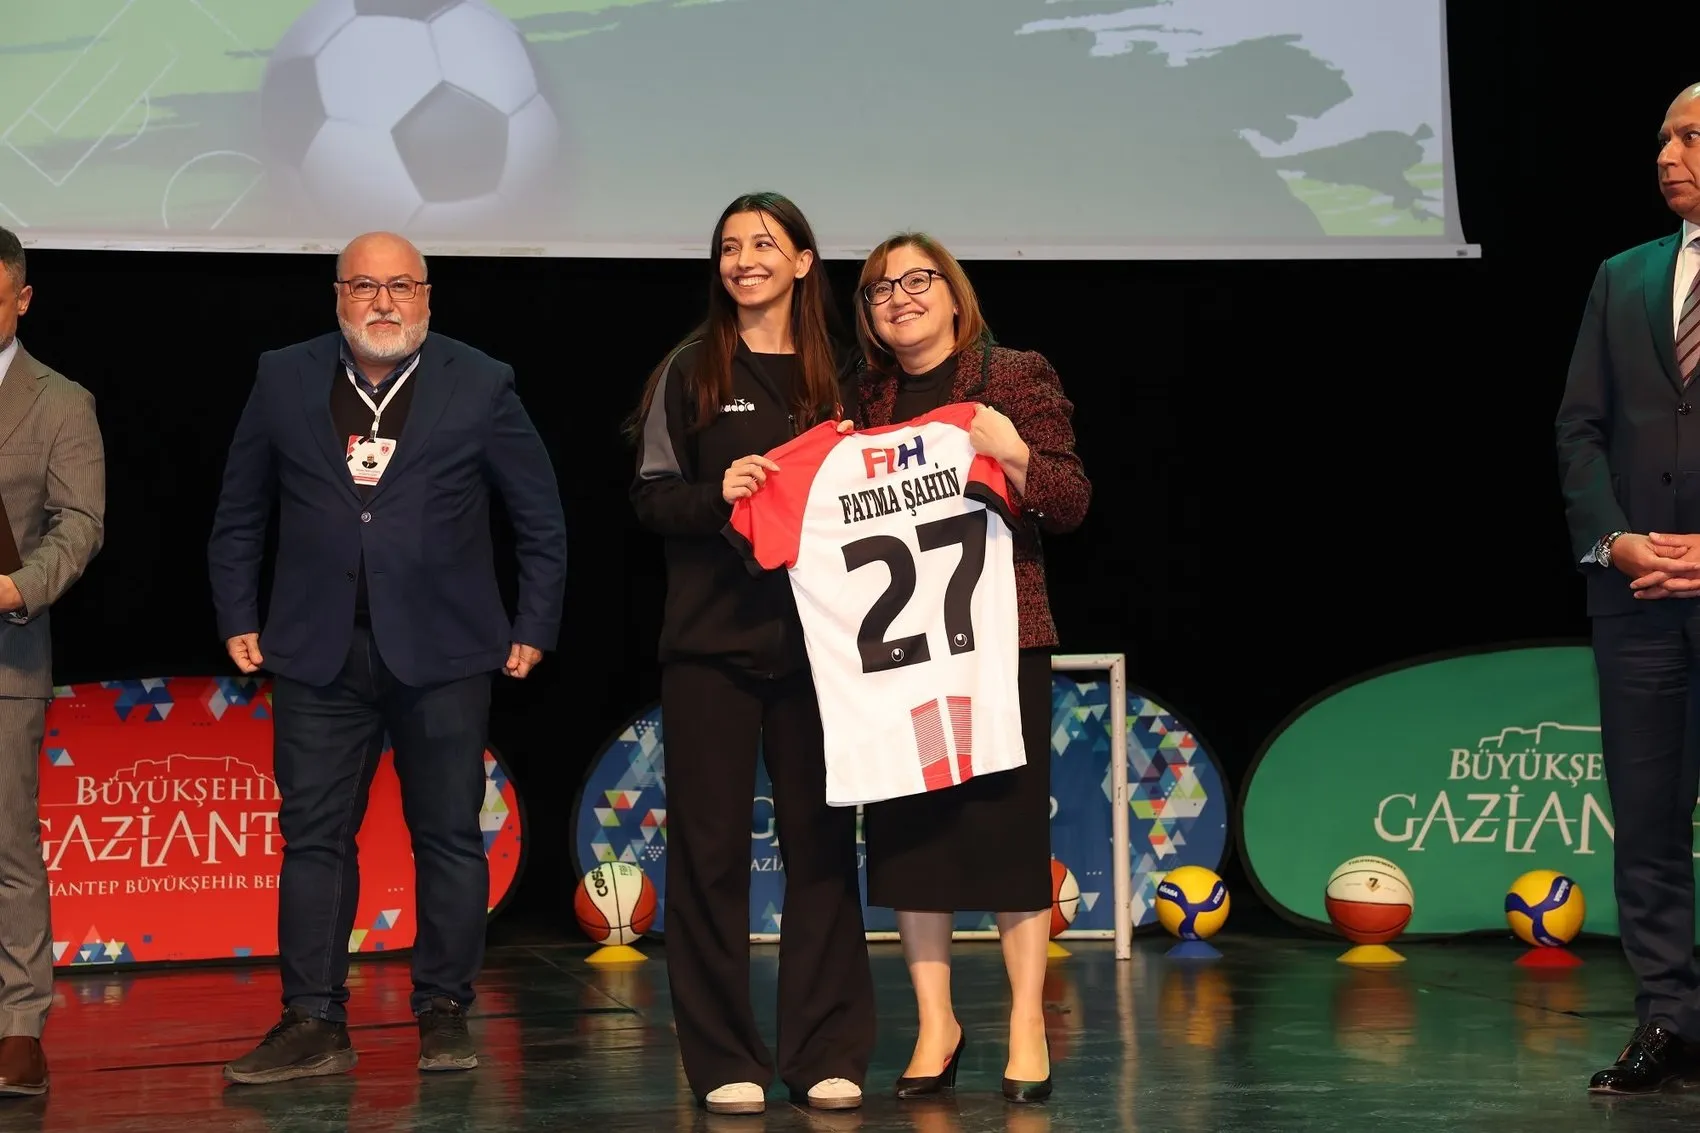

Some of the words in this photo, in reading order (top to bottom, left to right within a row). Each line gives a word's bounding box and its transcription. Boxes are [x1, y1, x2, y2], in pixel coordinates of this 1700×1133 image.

[720, 399, 755, 412] adora
[839, 485, 902, 524] FATMA
[902, 462, 961, 517] ŞAHİN
[841, 508, 988, 674] 27
[126, 872, 249, 894] BÜYÜKŞEHİR
